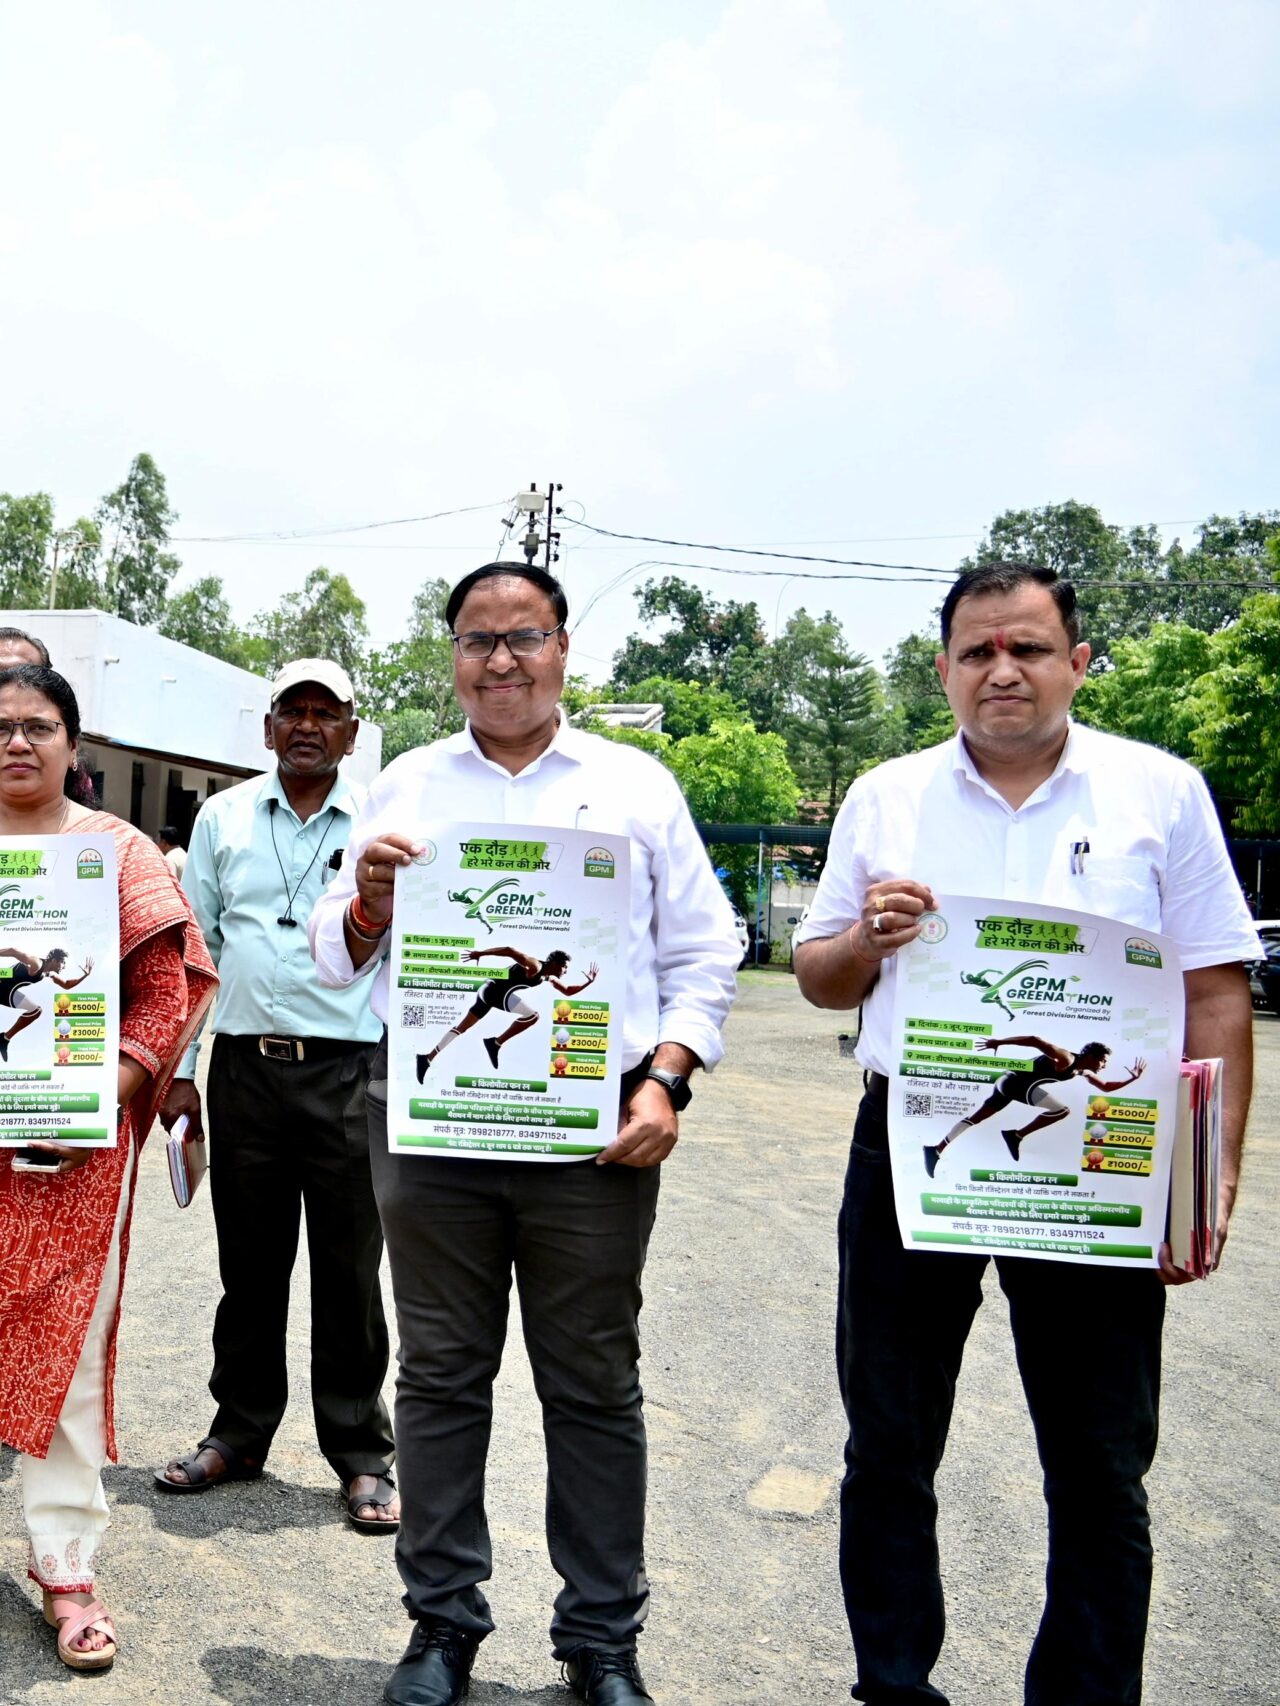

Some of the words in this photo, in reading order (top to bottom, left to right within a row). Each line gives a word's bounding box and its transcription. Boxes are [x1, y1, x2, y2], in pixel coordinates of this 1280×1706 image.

[459, 842, 482, 854] एक
[485, 839, 508, 858] दौड़
[467, 855, 478, 867] हरे
[481, 856, 492, 867] भरे
[495, 859, 513, 868] कल
[516, 857, 529, 869] की
[532, 858, 550, 870] ओर
[589, 864, 609, 874] GPM
[17, 865, 28, 875] की
[31, 866, 47, 876] ओर
[81, 866, 98, 874] GPM
[0, 898, 34, 909] GPM
[497, 892, 534, 906] GPM
[974, 919, 1002, 933] एक
[1006, 918, 1034, 937] दौड़
[984, 933, 997, 946] हरे
[1001, 935, 1015, 947] भरे
[1018, 938, 1040, 949] कल
[1044, 937, 1060, 950] की
[1063, 940, 1084, 953] ओर
[1131, 951, 1154, 965] GPM
[1020, 975, 1066, 992] GPM
[1047, 1011, 1075, 1019] Division
[1077, 1013, 1110, 1022] Marwahi
[1065, 1005, 1100, 1014] Organized
[433, 1126, 451, 1134] संपर्क
[468, 1128, 516, 1138] 7898218777,
[518, 1130, 566, 1140] 8349711524
[952, 1221, 972, 1230] संपर्क
[993, 1226, 1048, 1237] 7898218777,
[1050, 1229, 1104, 1239] 8349711524
